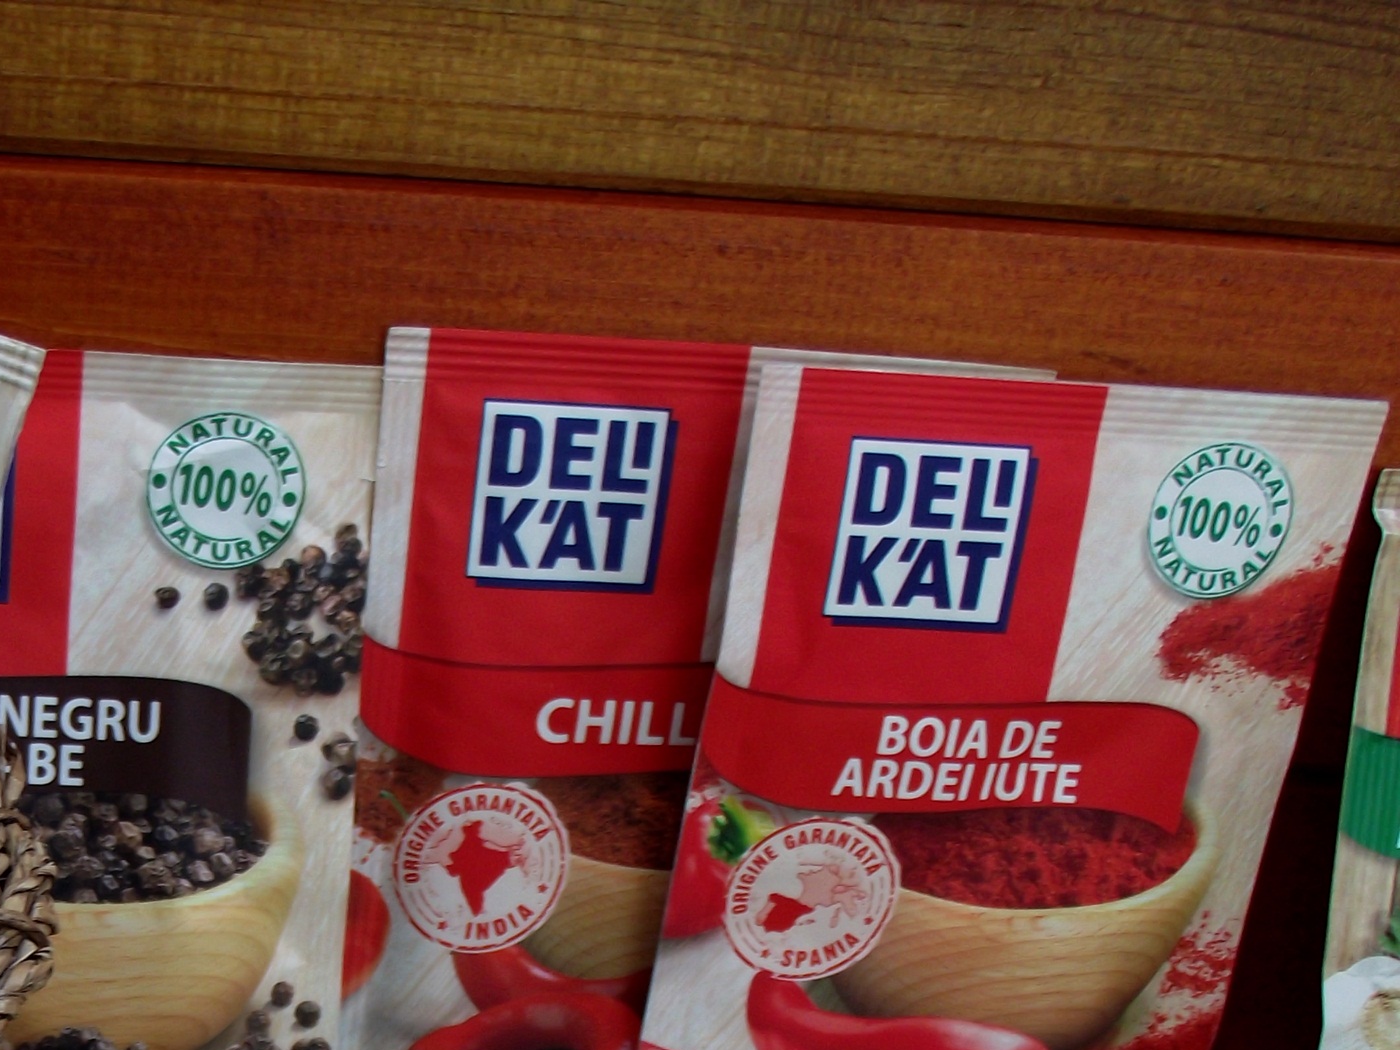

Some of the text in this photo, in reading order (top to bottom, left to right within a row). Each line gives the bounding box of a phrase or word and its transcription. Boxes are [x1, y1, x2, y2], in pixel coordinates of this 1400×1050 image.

[166, 417, 298, 485] NATURAL
[486, 413, 656, 494] DELI
[179, 463, 272, 518] 100%
[850, 451, 1019, 533] DELI
[1171, 447, 1289, 516] NATURAL
[156, 504, 291, 562] NATURAL
[1176, 495, 1261, 548] 100%
[1154, 535, 1274, 591] NATURAL
[875, 715, 1062, 760] BOIA DE
[831, 757, 1082, 804] ARDEI IUTE
[403, 810, 445, 884] ORIGINE
[731, 844, 780, 915] ORIGINE
[464, 903, 535, 940] INDIA
[779, 932, 860, 968] SPANIA
